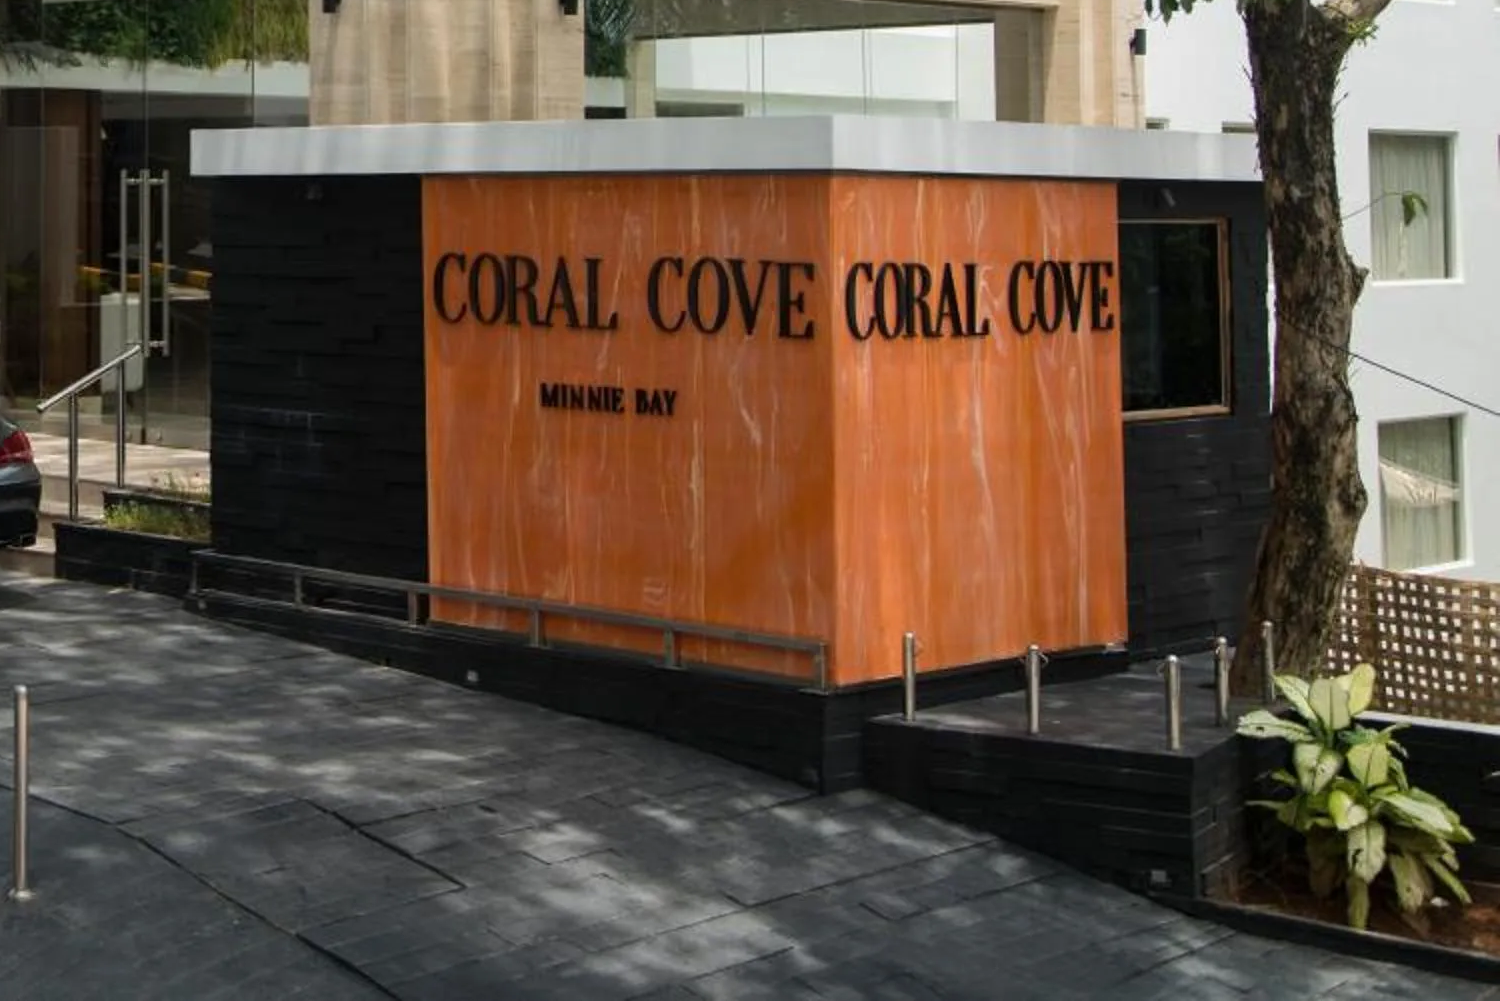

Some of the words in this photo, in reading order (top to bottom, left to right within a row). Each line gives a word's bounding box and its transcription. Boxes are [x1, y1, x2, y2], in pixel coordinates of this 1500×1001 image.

[433, 252, 618, 331] CORAL
[647, 257, 814, 339] COVE
[845, 261, 990, 341] CORAL
[1008, 260, 1114, 335] COVE
[539, 382, 625, 414] MINNIE
[635, 388, 678, 416] BAY
